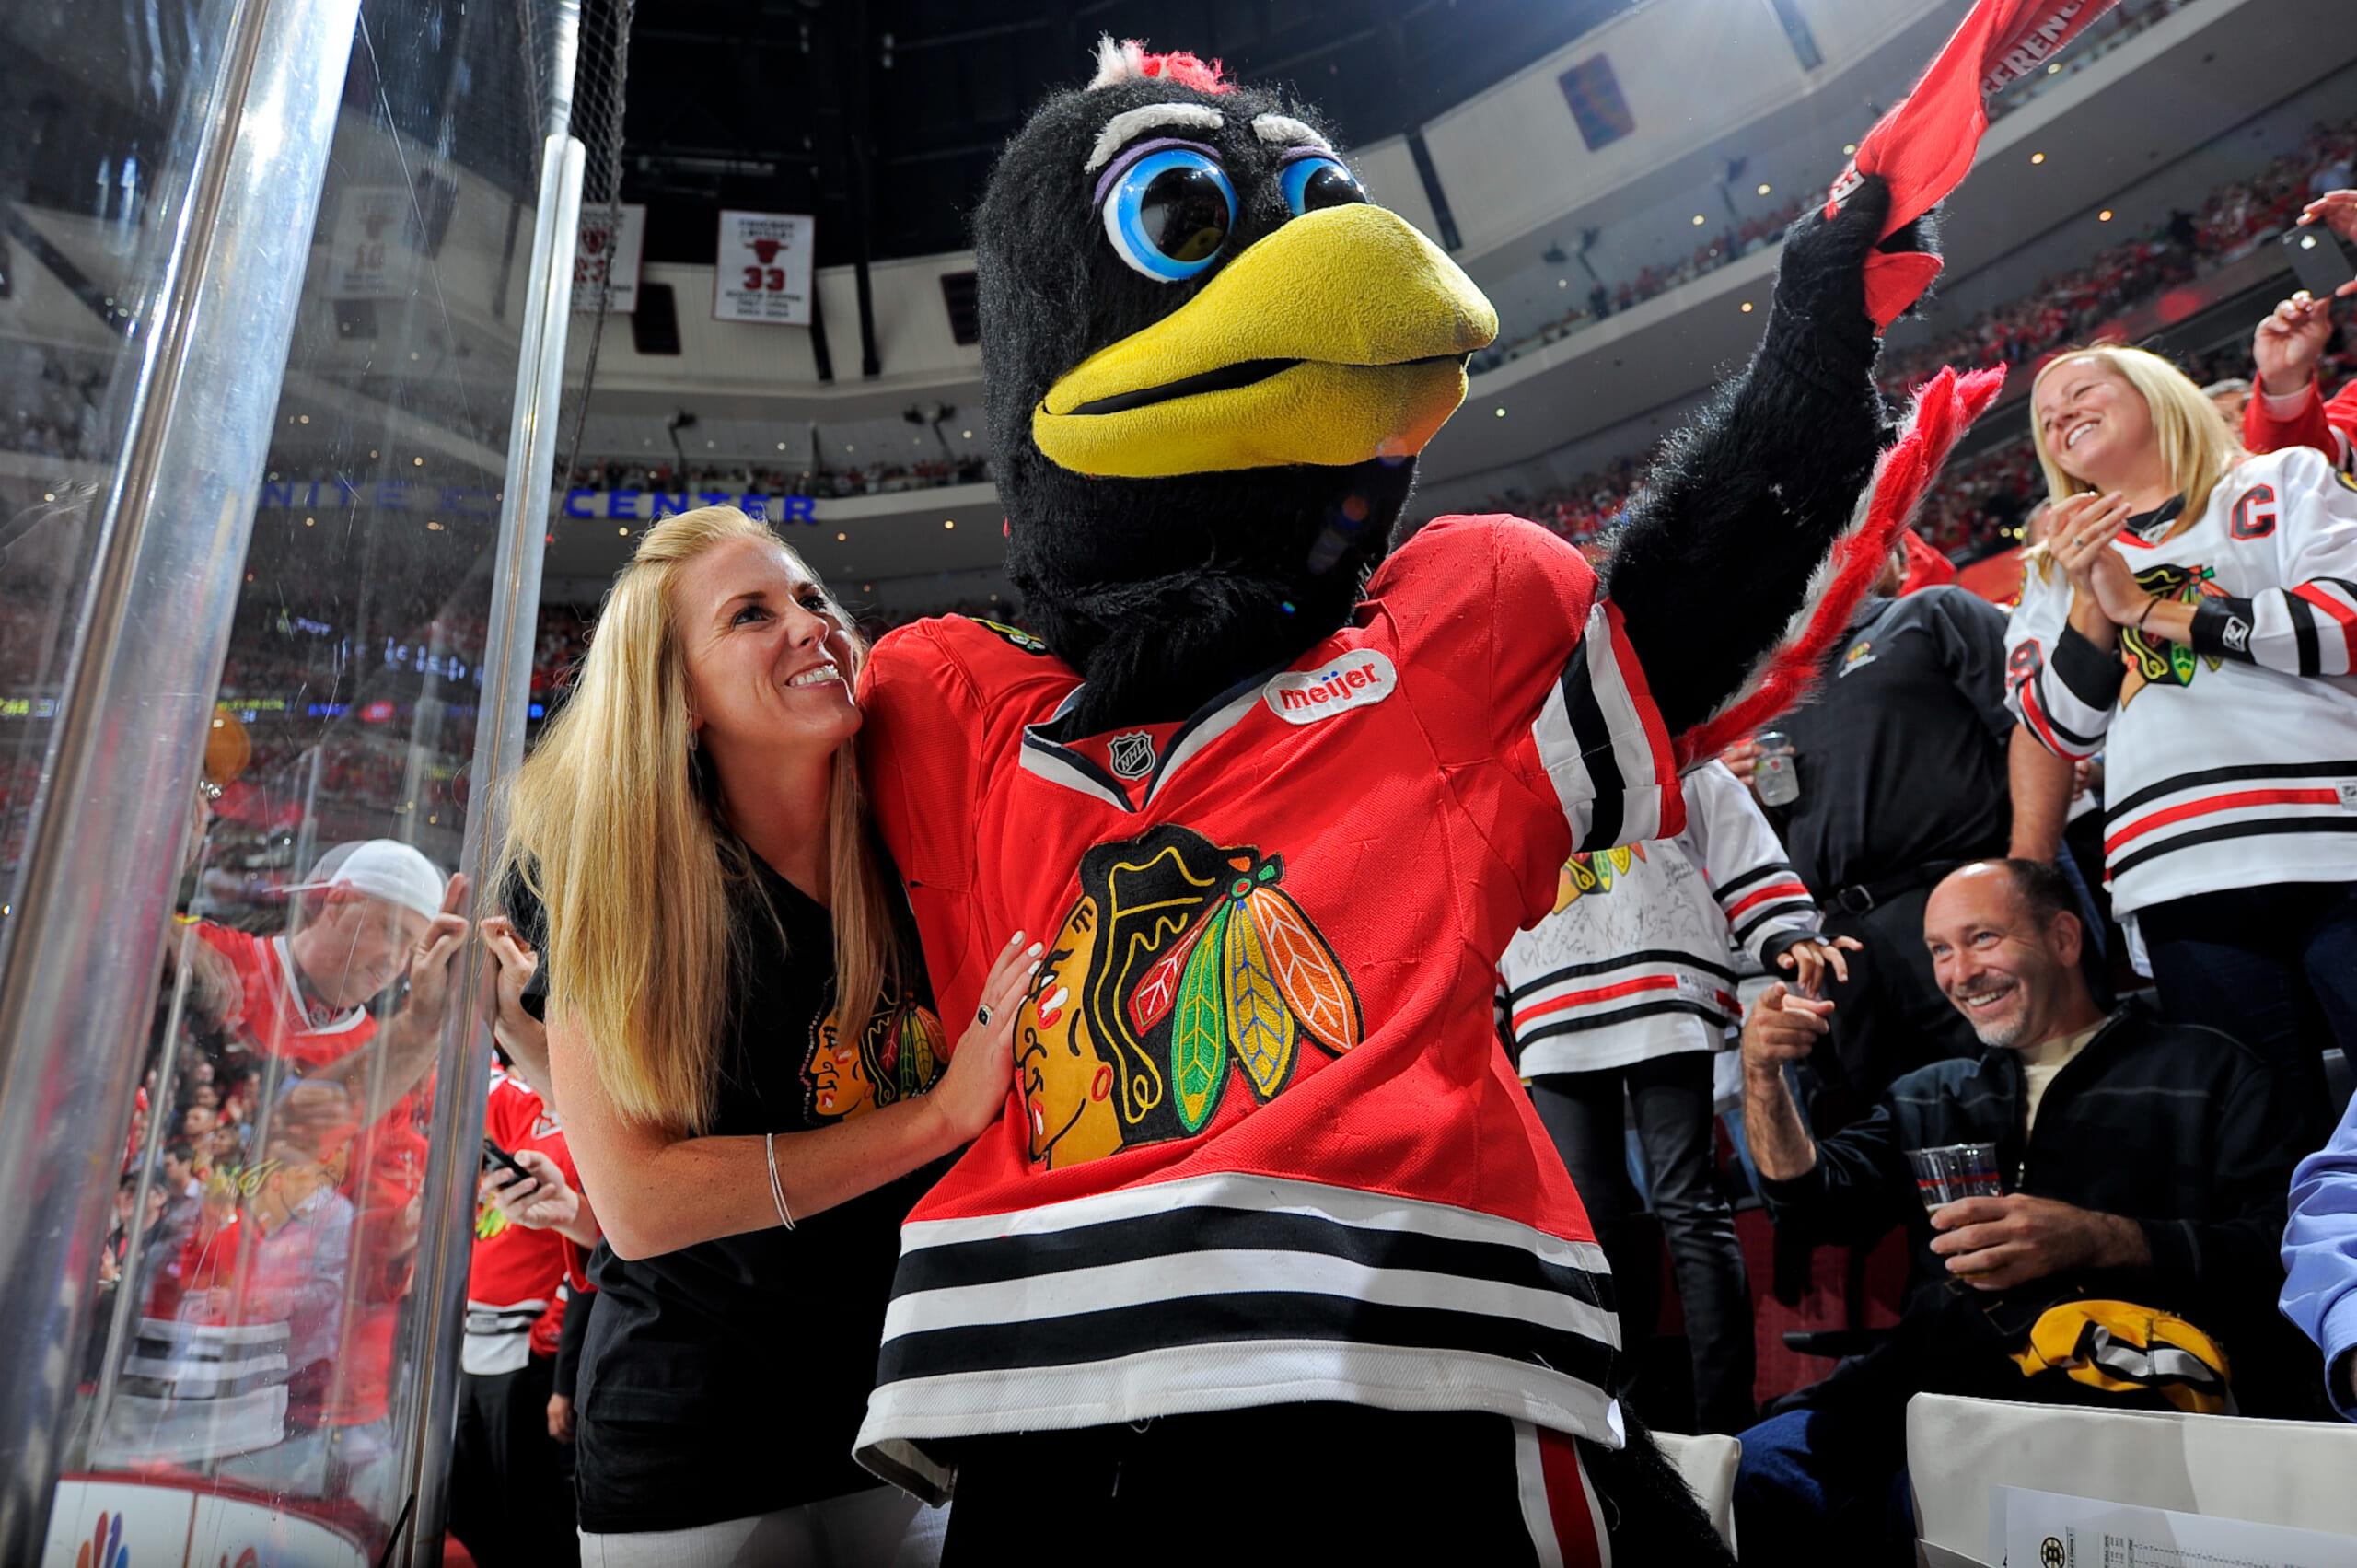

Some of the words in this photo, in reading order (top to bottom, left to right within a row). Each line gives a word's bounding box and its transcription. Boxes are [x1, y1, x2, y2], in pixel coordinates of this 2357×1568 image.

[1980, 0, 2087, 100] FERENC
[742, 265, 785, 291] 33
[564, 487, 817, 525] CENTER
[2231, 483, 2275, 541] C
[1279, 663, 1381, 710] meijer
[1120, 742, 1147, 771] NHL
